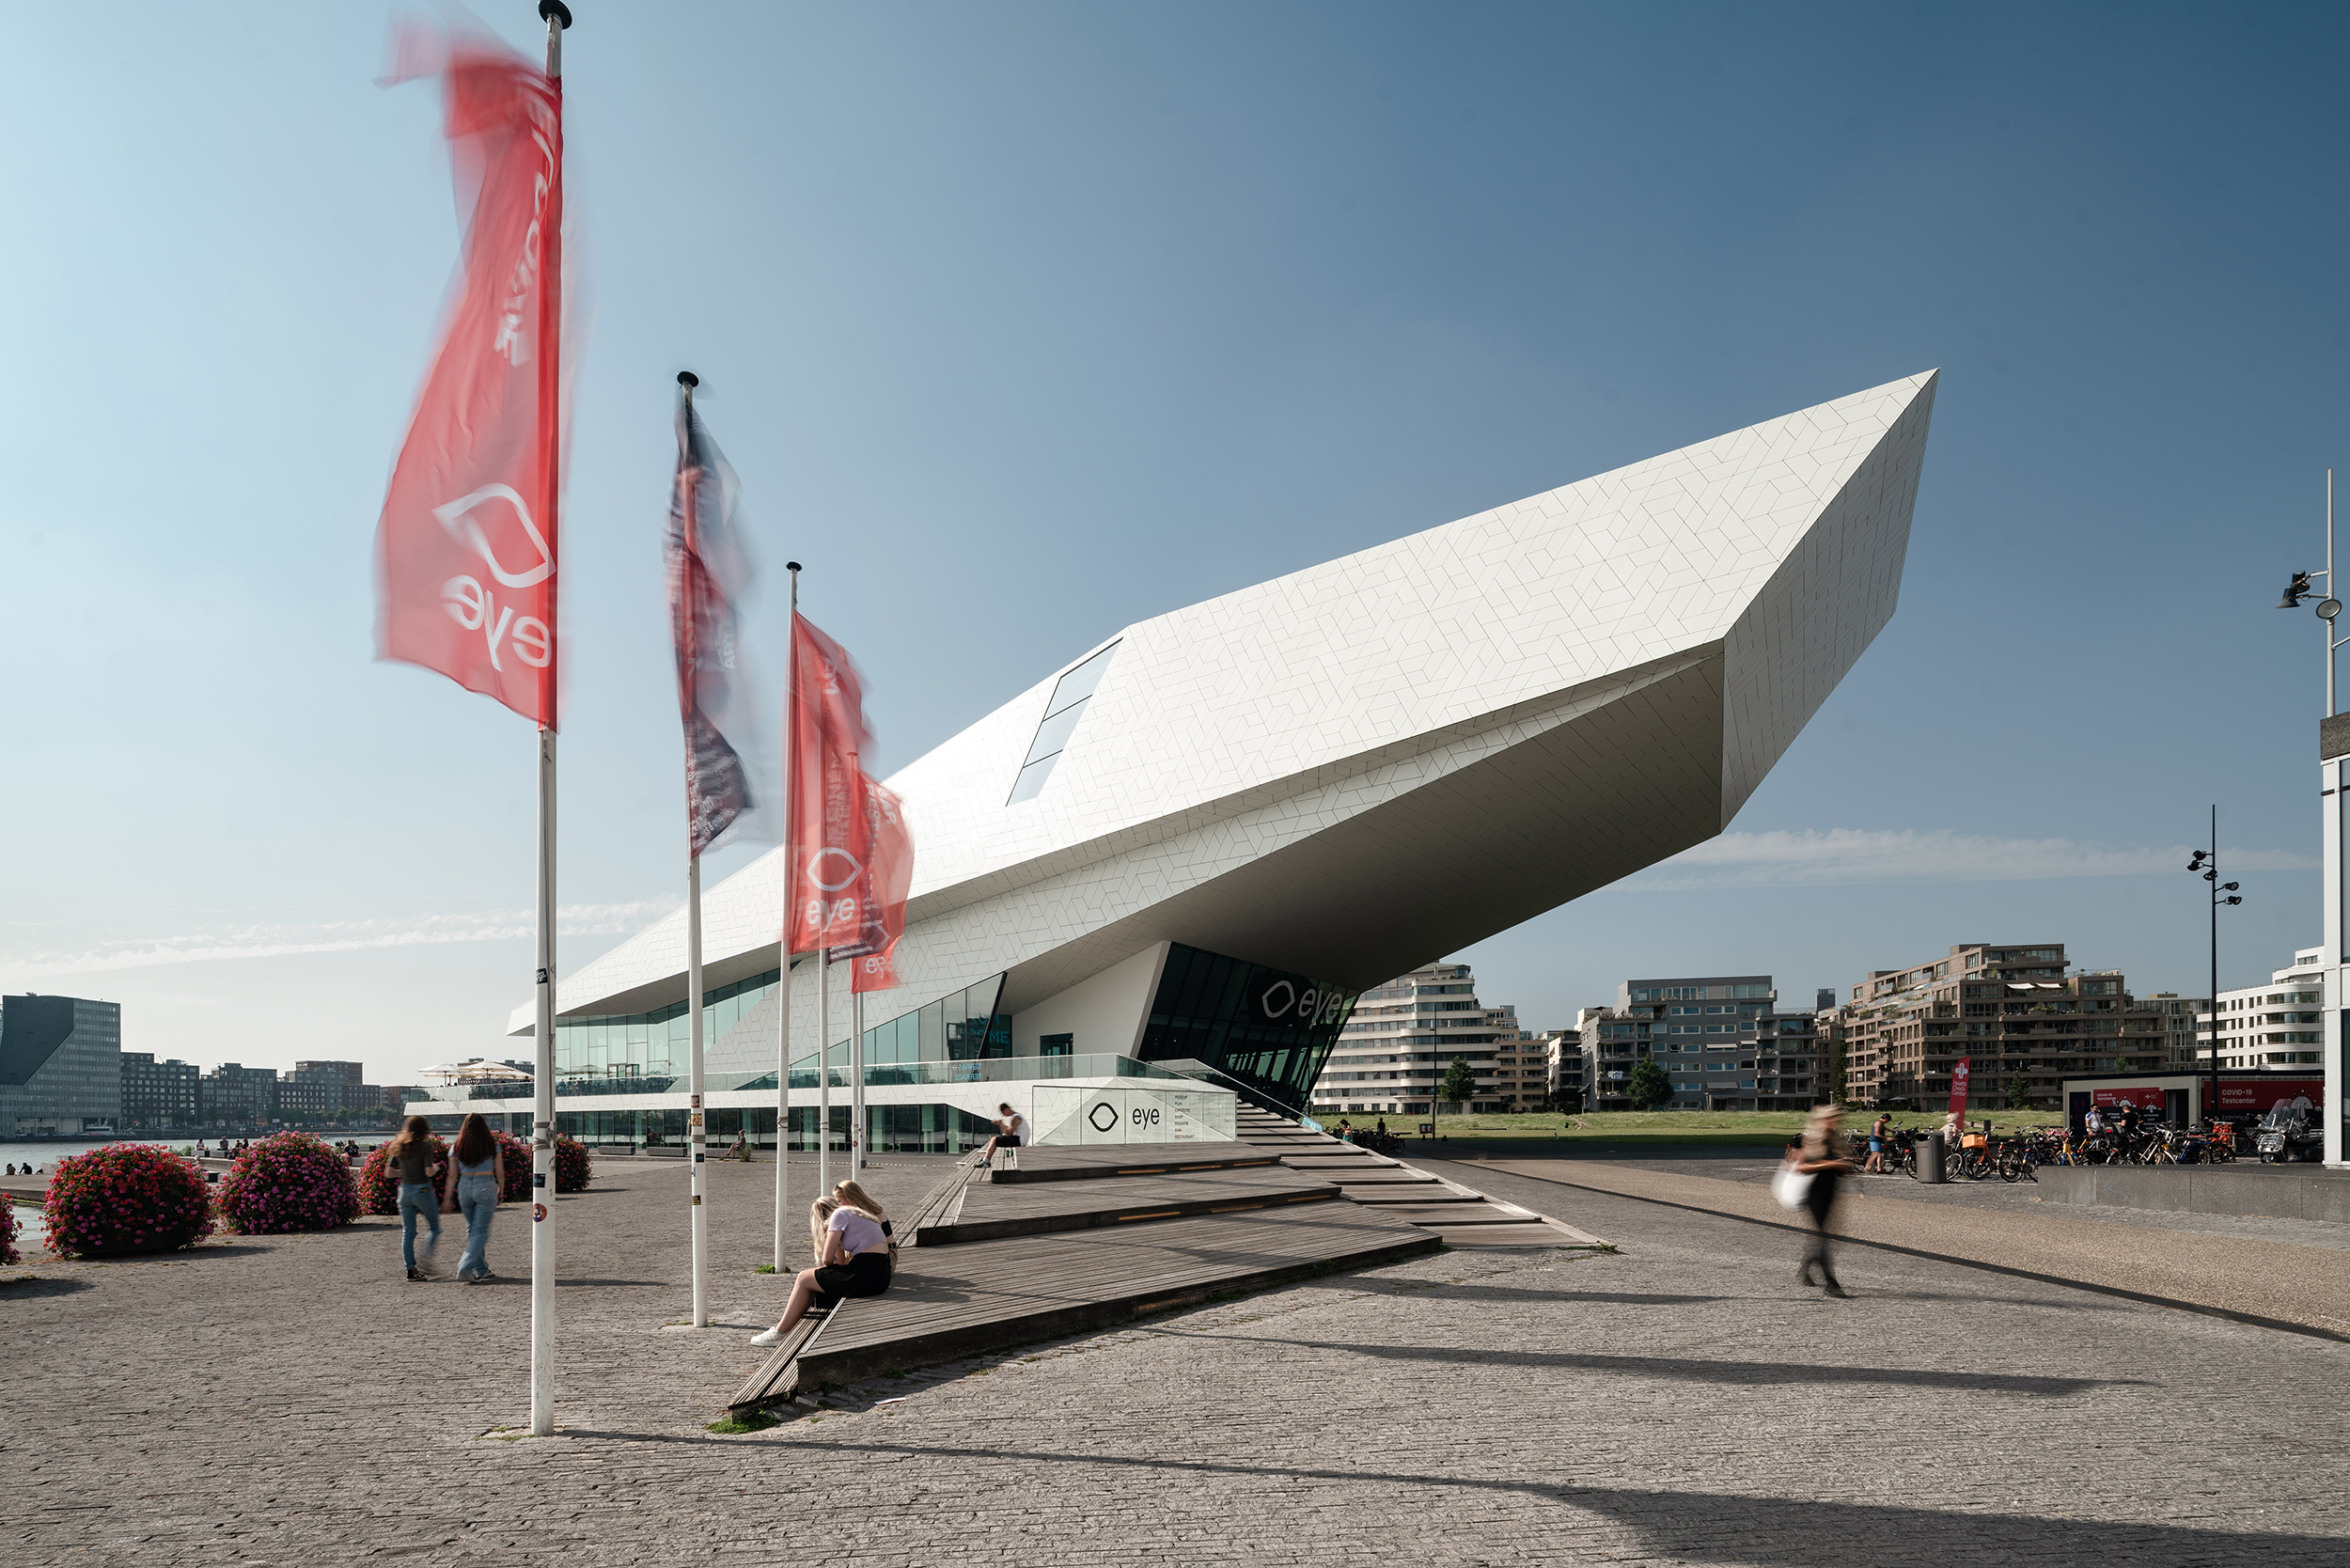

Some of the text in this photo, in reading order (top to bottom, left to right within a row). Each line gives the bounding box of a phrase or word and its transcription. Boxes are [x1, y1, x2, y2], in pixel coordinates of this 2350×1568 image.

[805, 897, 855, 933] eye
[1298, 988, 1343, 1030] eye
[1132, 1108, 1160, 1130] eye
